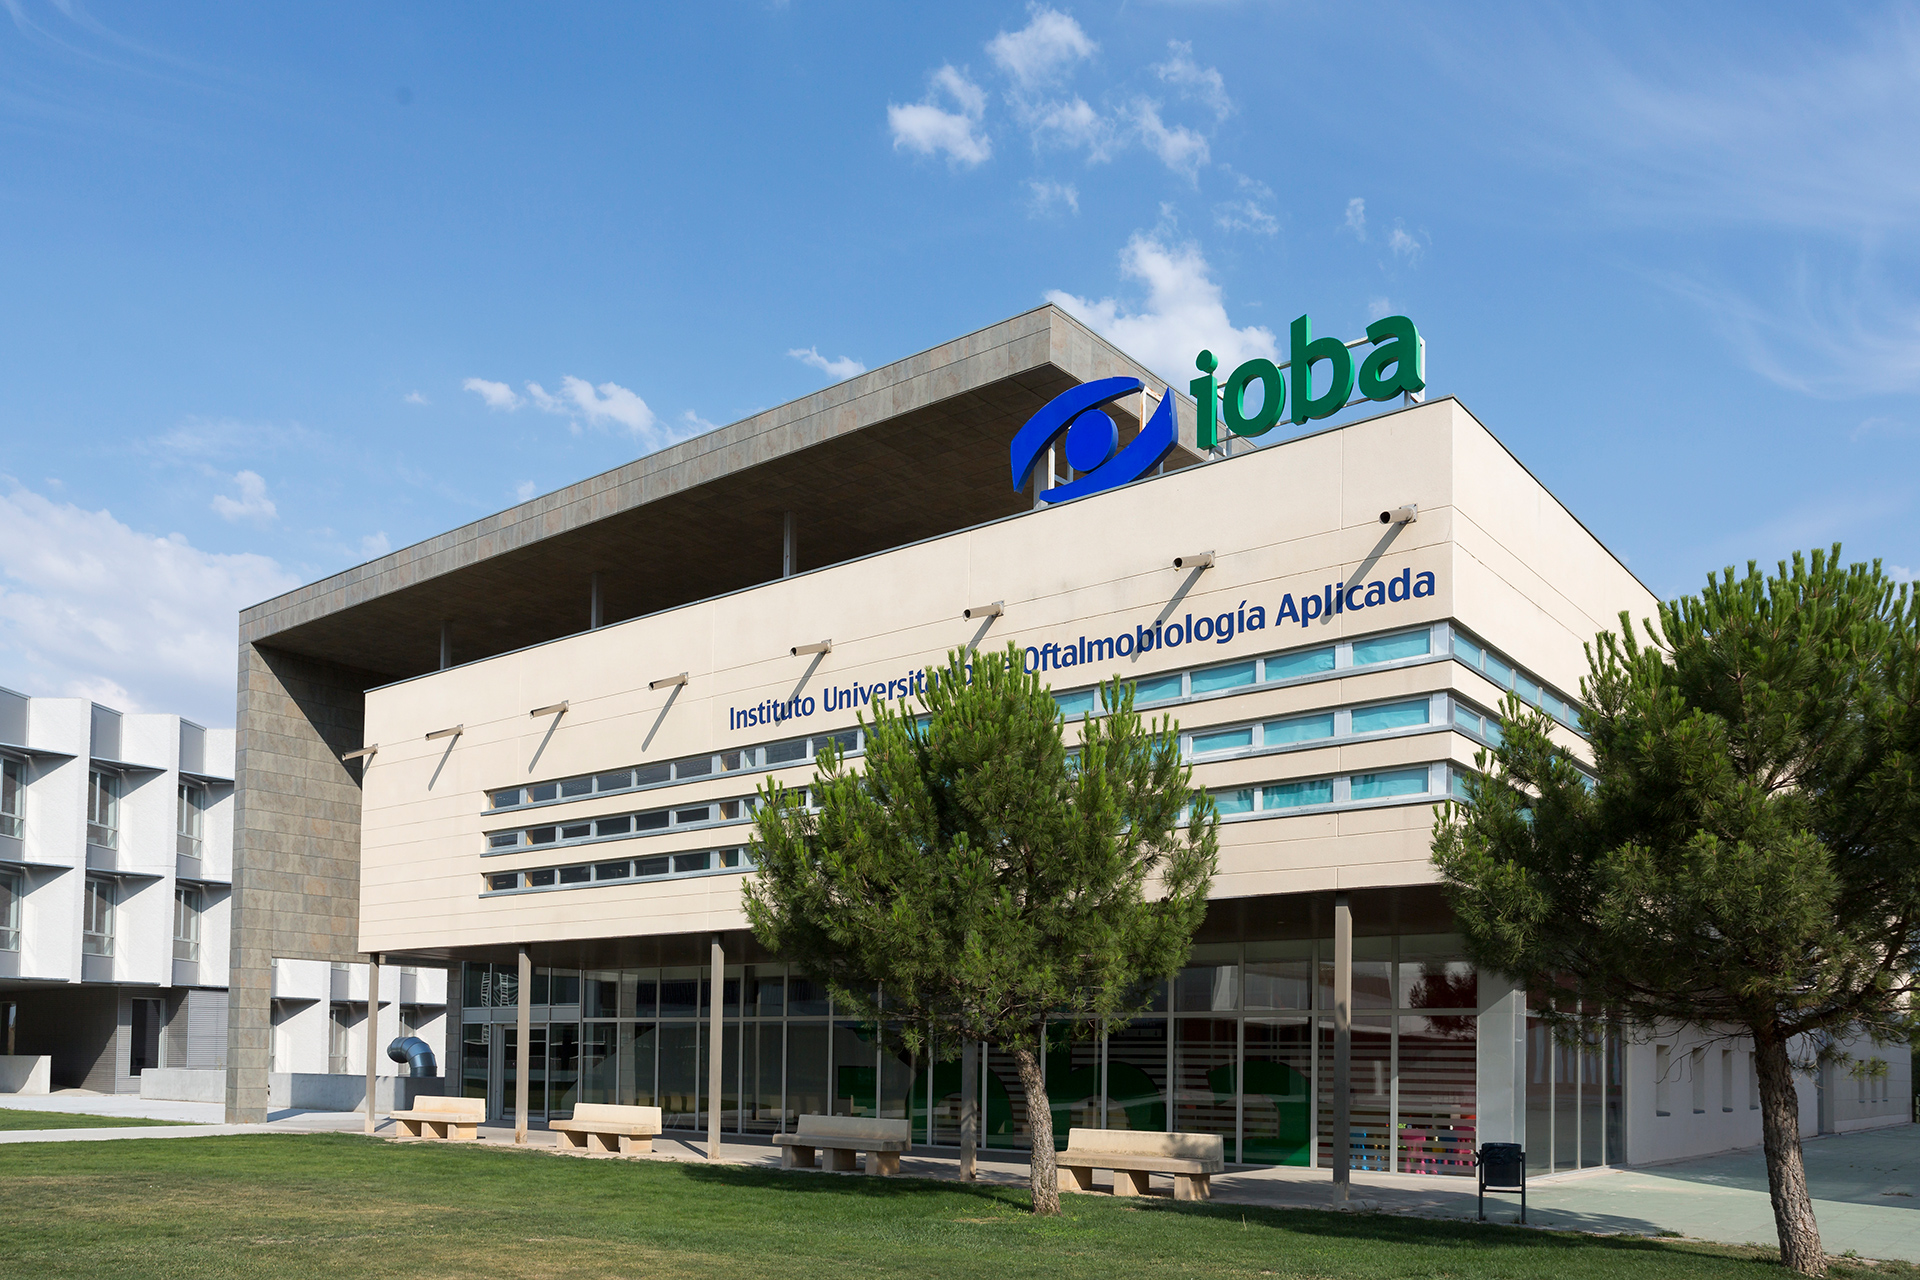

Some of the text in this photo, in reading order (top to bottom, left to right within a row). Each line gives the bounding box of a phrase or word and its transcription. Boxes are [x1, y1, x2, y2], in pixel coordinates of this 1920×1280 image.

[1189, 314, 1425, 450] ioba
[730, 694, 815, 730] Instituto
[1023, 600, 1266, 674] Oftalmobiología
[1275, 567, 1435, 628] Aplicada
